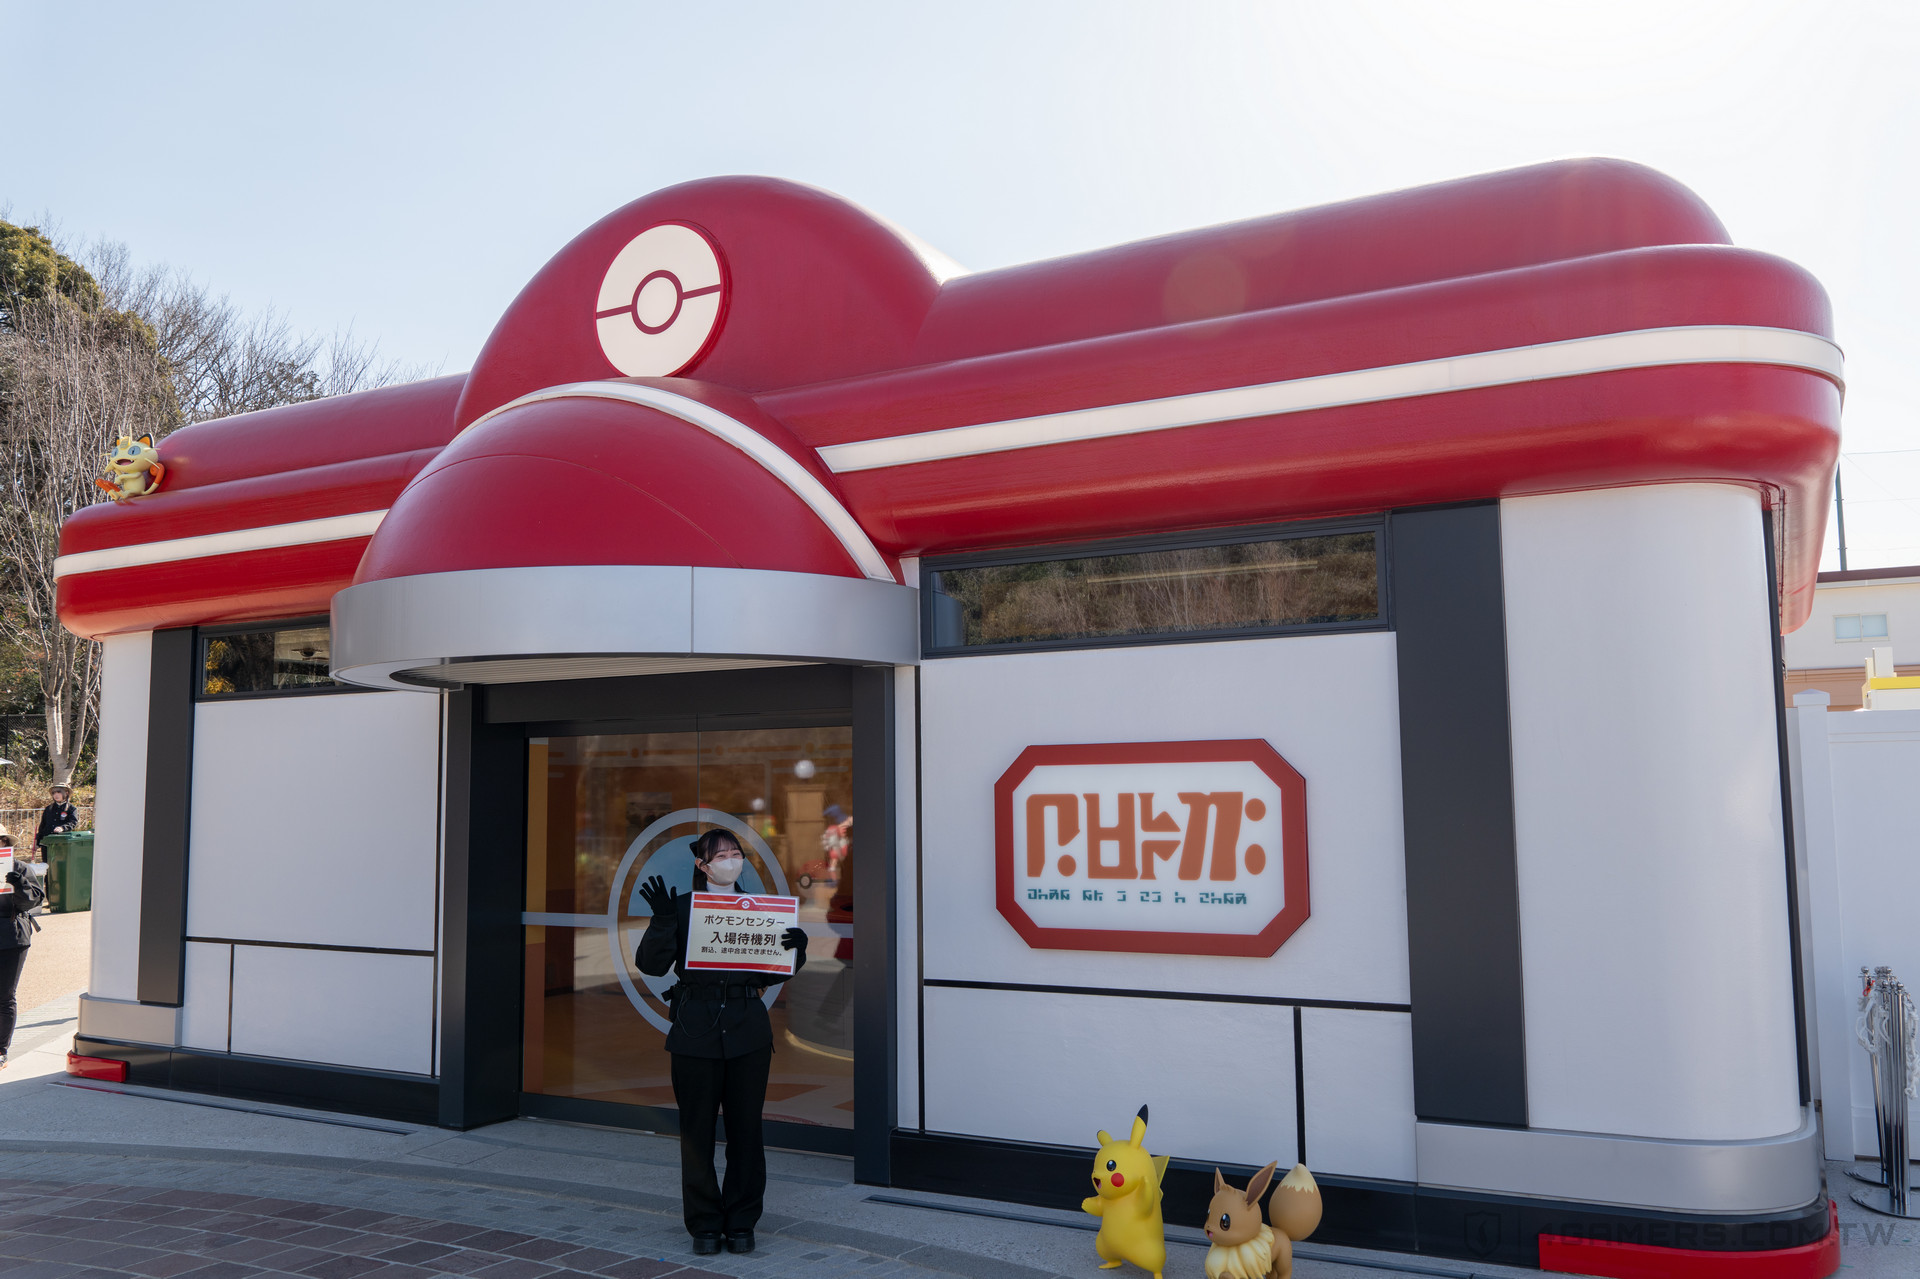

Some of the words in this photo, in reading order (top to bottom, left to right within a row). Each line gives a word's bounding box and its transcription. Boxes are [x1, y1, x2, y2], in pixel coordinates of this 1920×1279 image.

[704, 914, 785, 927] ポケモンセンター
[710, 931, 776, 946] 入場待機列
